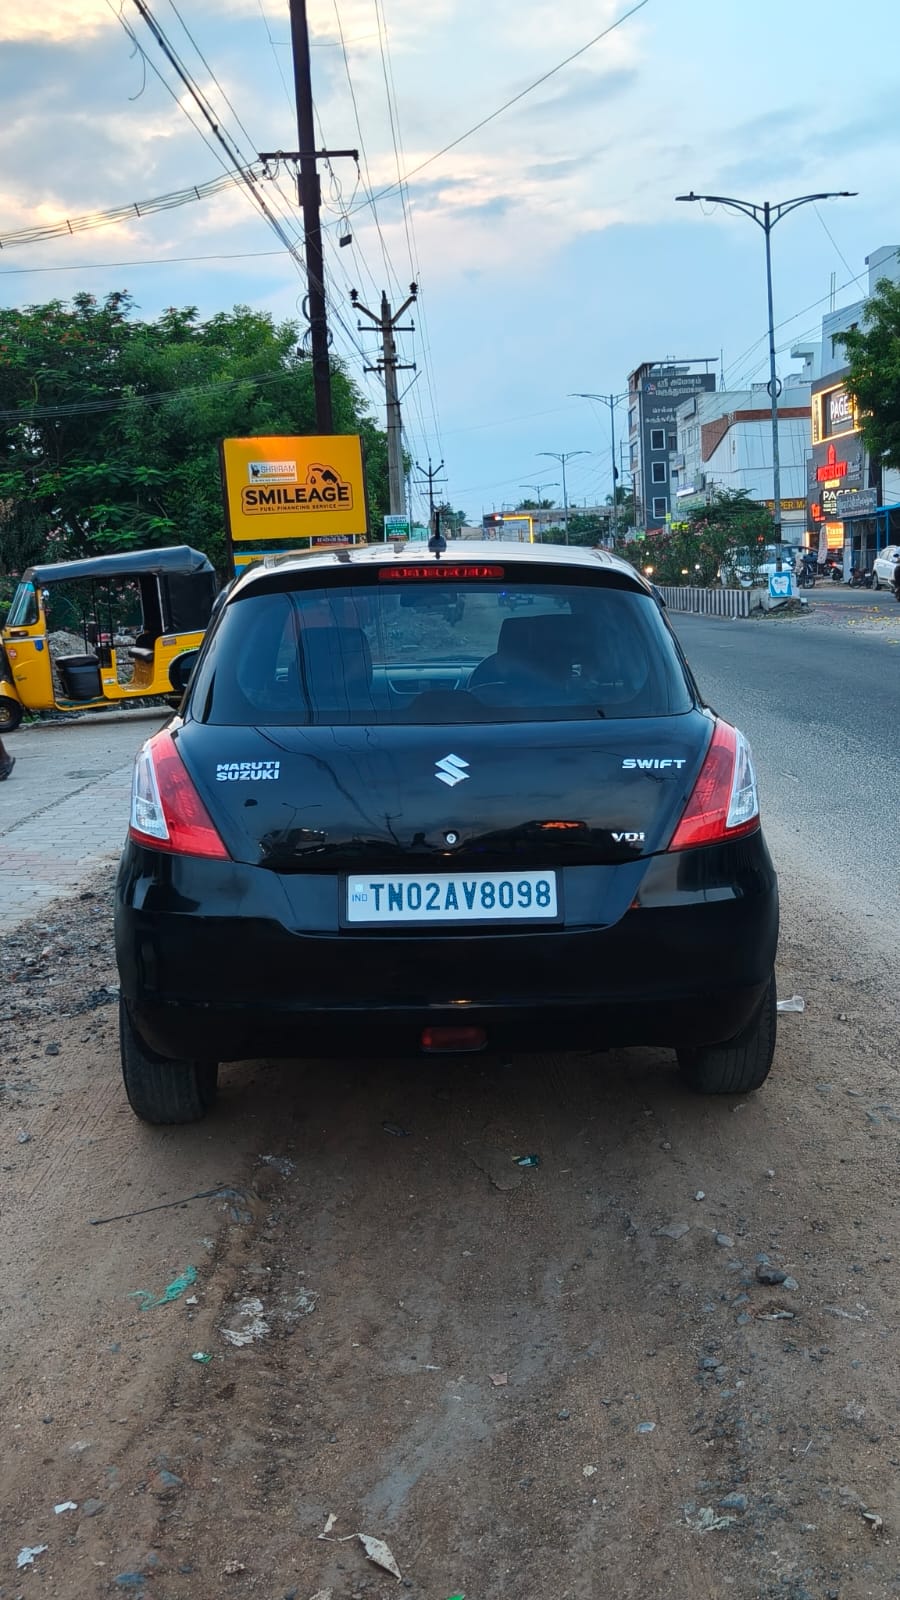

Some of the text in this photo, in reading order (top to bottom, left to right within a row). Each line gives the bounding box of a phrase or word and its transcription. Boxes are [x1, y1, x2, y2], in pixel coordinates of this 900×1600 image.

[261, 464, 295, 473] SHRIRAM
[245, 487, 350, 506] SMILEAGE
[278, 504, 310, 512] FINANCING
[216, 761, 280, 772] MARUTI
[622, 759, 686, 769] SWIFT
[216, 770, 280, 781] SUZUKI
[351, 880, 552, 912] IND TN02AV8098
